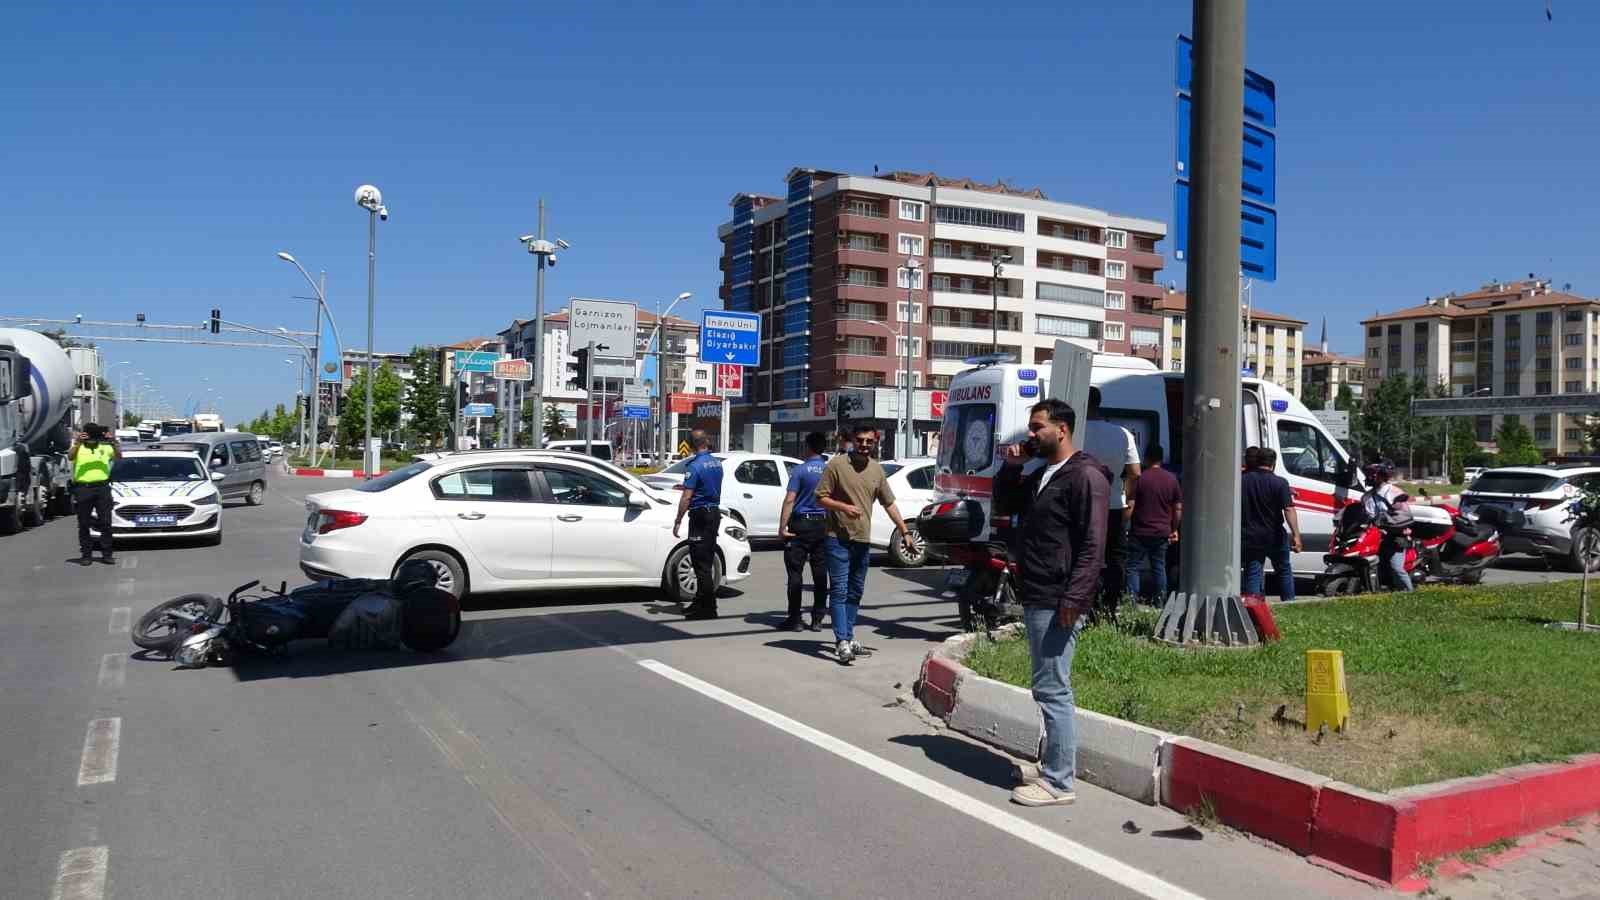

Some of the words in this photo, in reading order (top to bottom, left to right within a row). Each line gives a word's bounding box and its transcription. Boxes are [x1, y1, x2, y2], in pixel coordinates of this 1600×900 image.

[575, 307, 623, 319] Garnizon
[574, 321, 632, 331] Lojmanları
[707, 329, 736, 342] Elazığ
[706, 338, 757, 352] Diyarbakır
